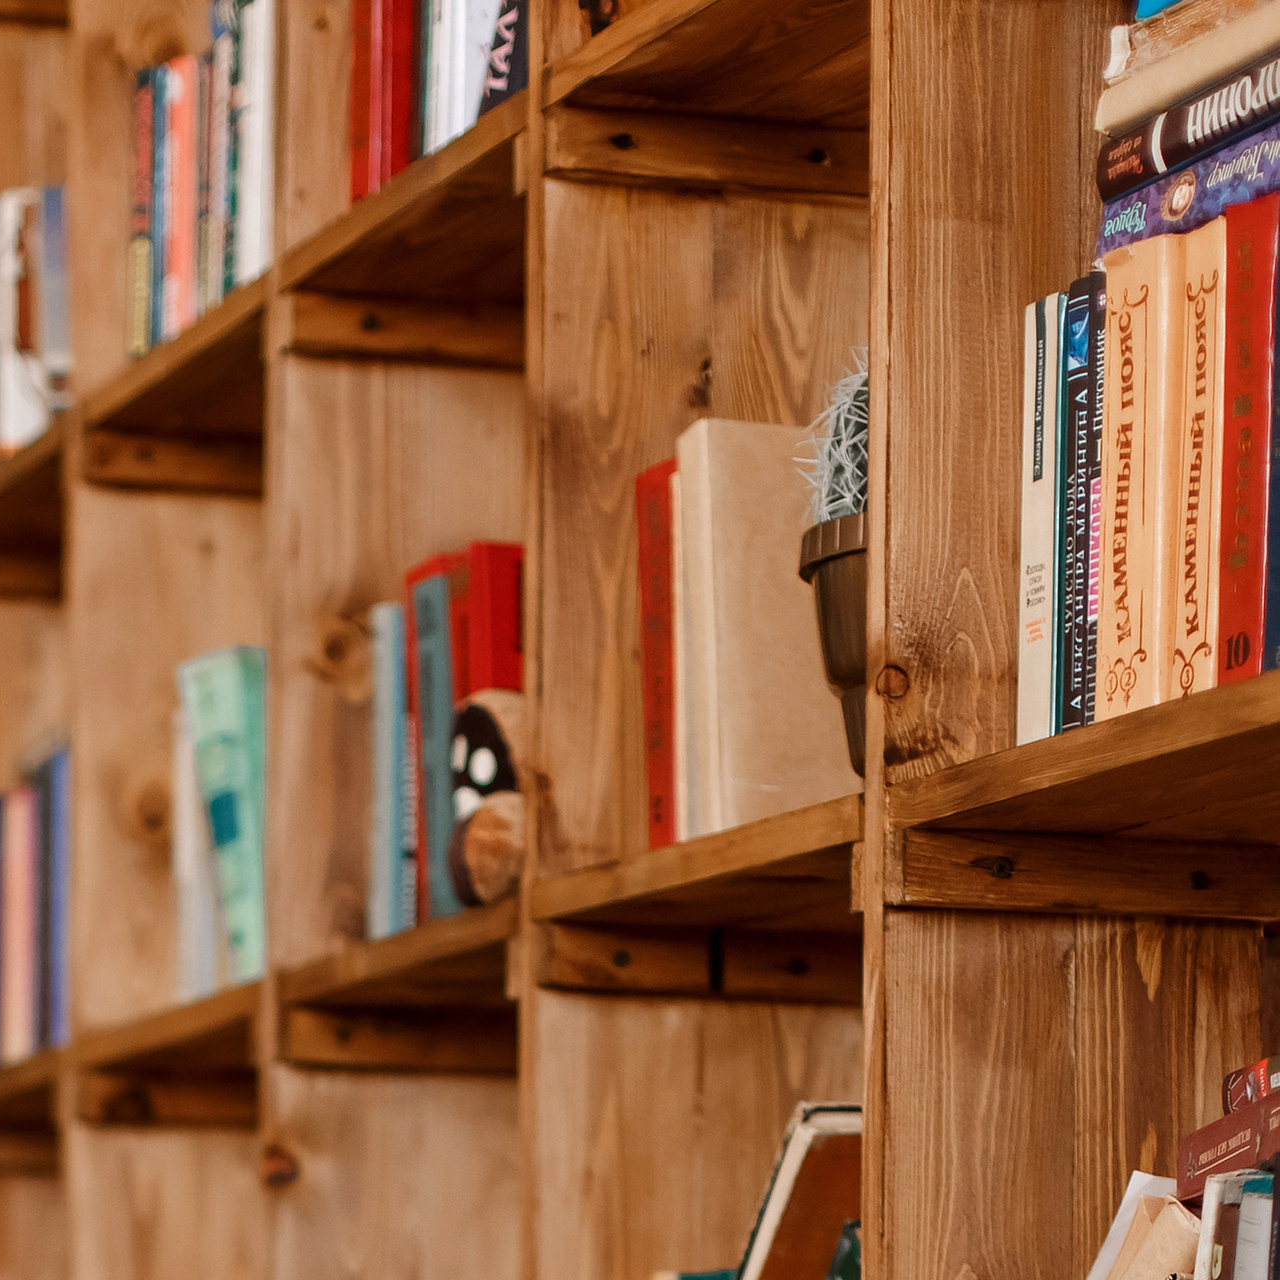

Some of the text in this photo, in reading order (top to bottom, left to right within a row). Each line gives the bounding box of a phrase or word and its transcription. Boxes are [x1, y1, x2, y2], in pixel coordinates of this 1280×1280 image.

[1064, 474, 1075, 633] ЧУВСТВО ЛЬДА
[1070, 388, 1090, 711] АЛЕКСАНДРА МАРИНИНА
[1113, 310, 1135, 645] КАМЕННЫЙ ПОЯС
[1184, 298, 1209, 637] КАМЕННЫЙ ПОЯС
[1225, 632, 1250, 671] 10
